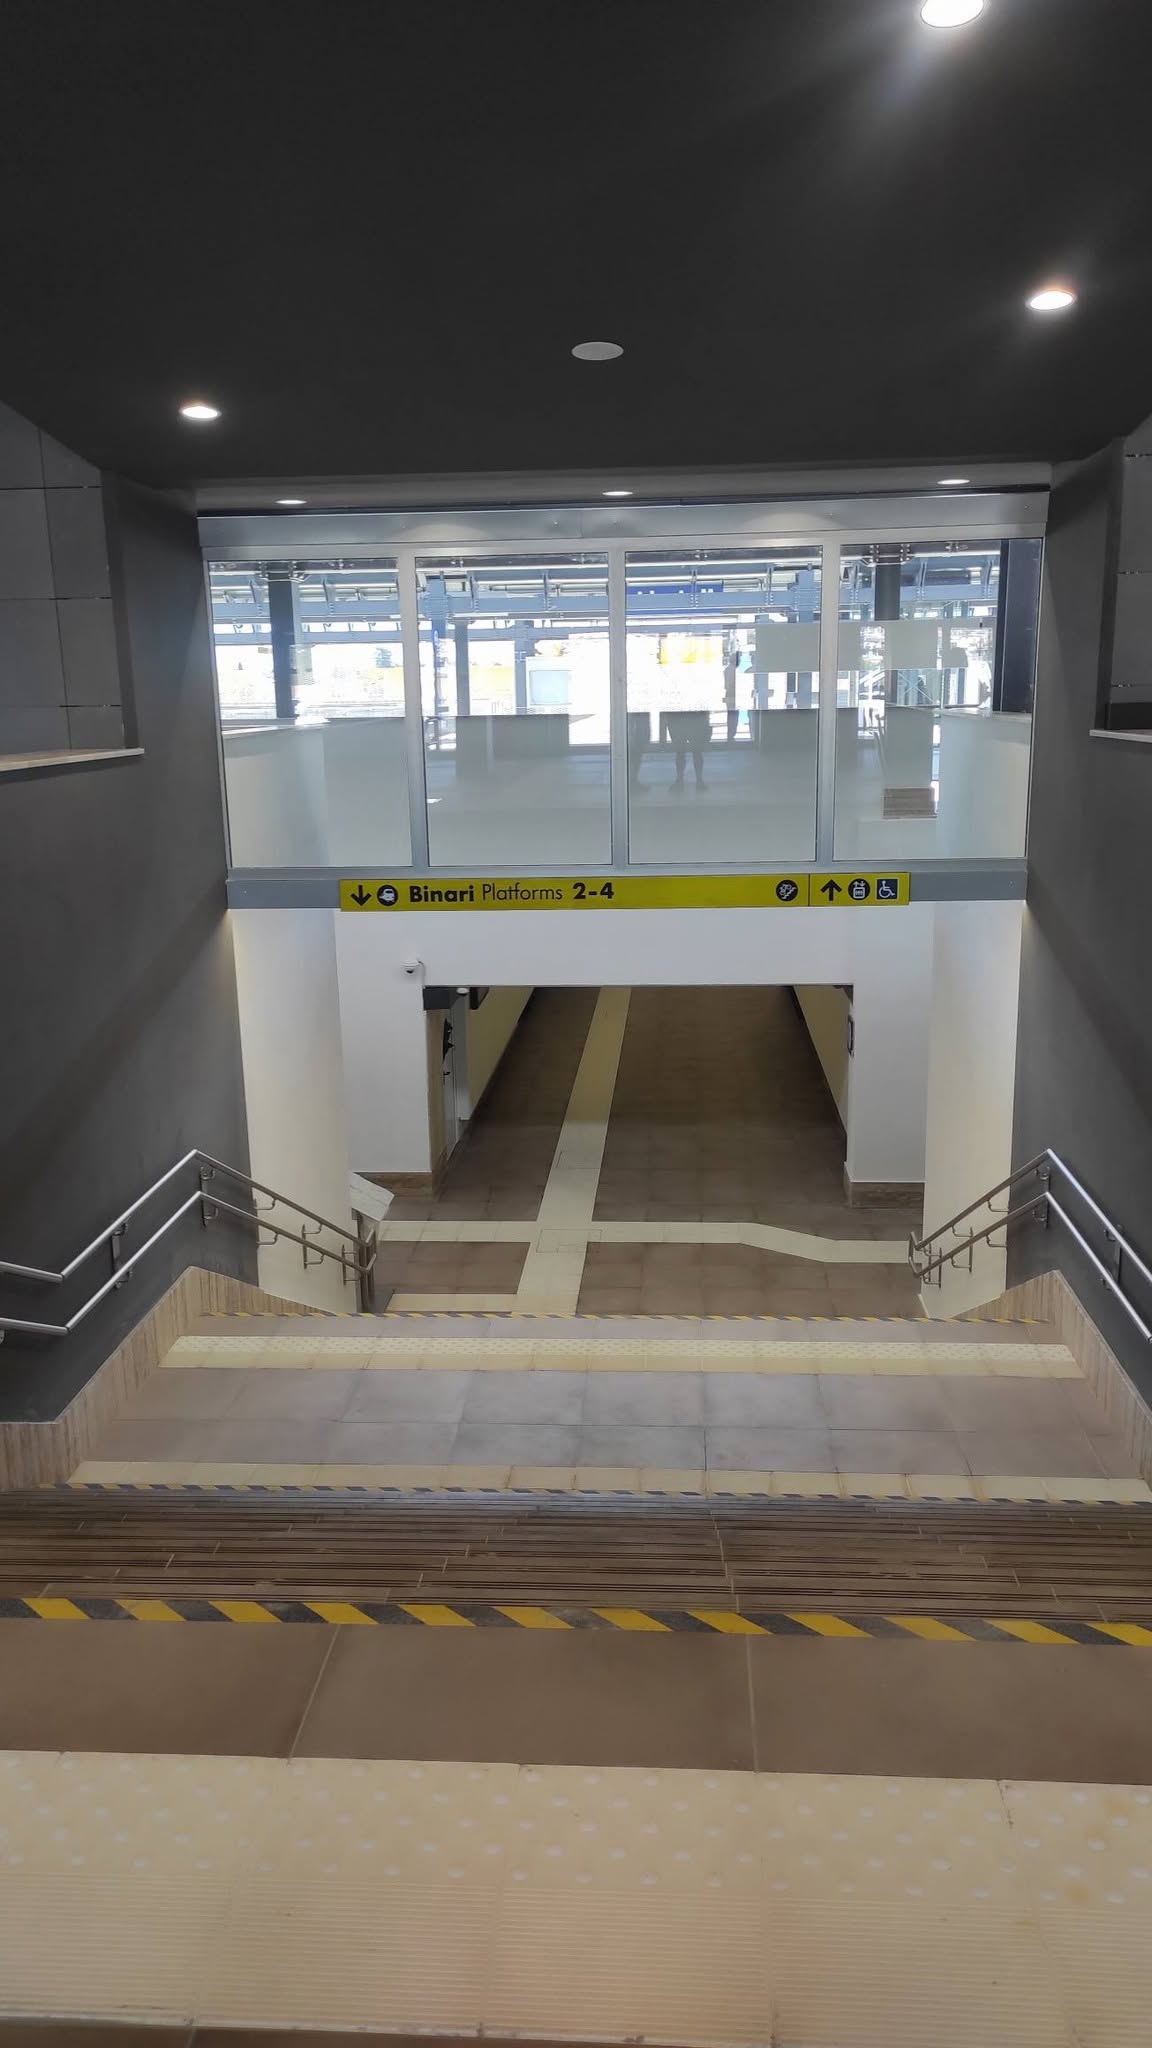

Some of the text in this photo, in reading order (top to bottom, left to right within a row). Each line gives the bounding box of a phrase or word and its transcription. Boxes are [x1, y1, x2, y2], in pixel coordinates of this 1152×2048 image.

[409, 882, 615, 903] Binari Platforms 2-4
